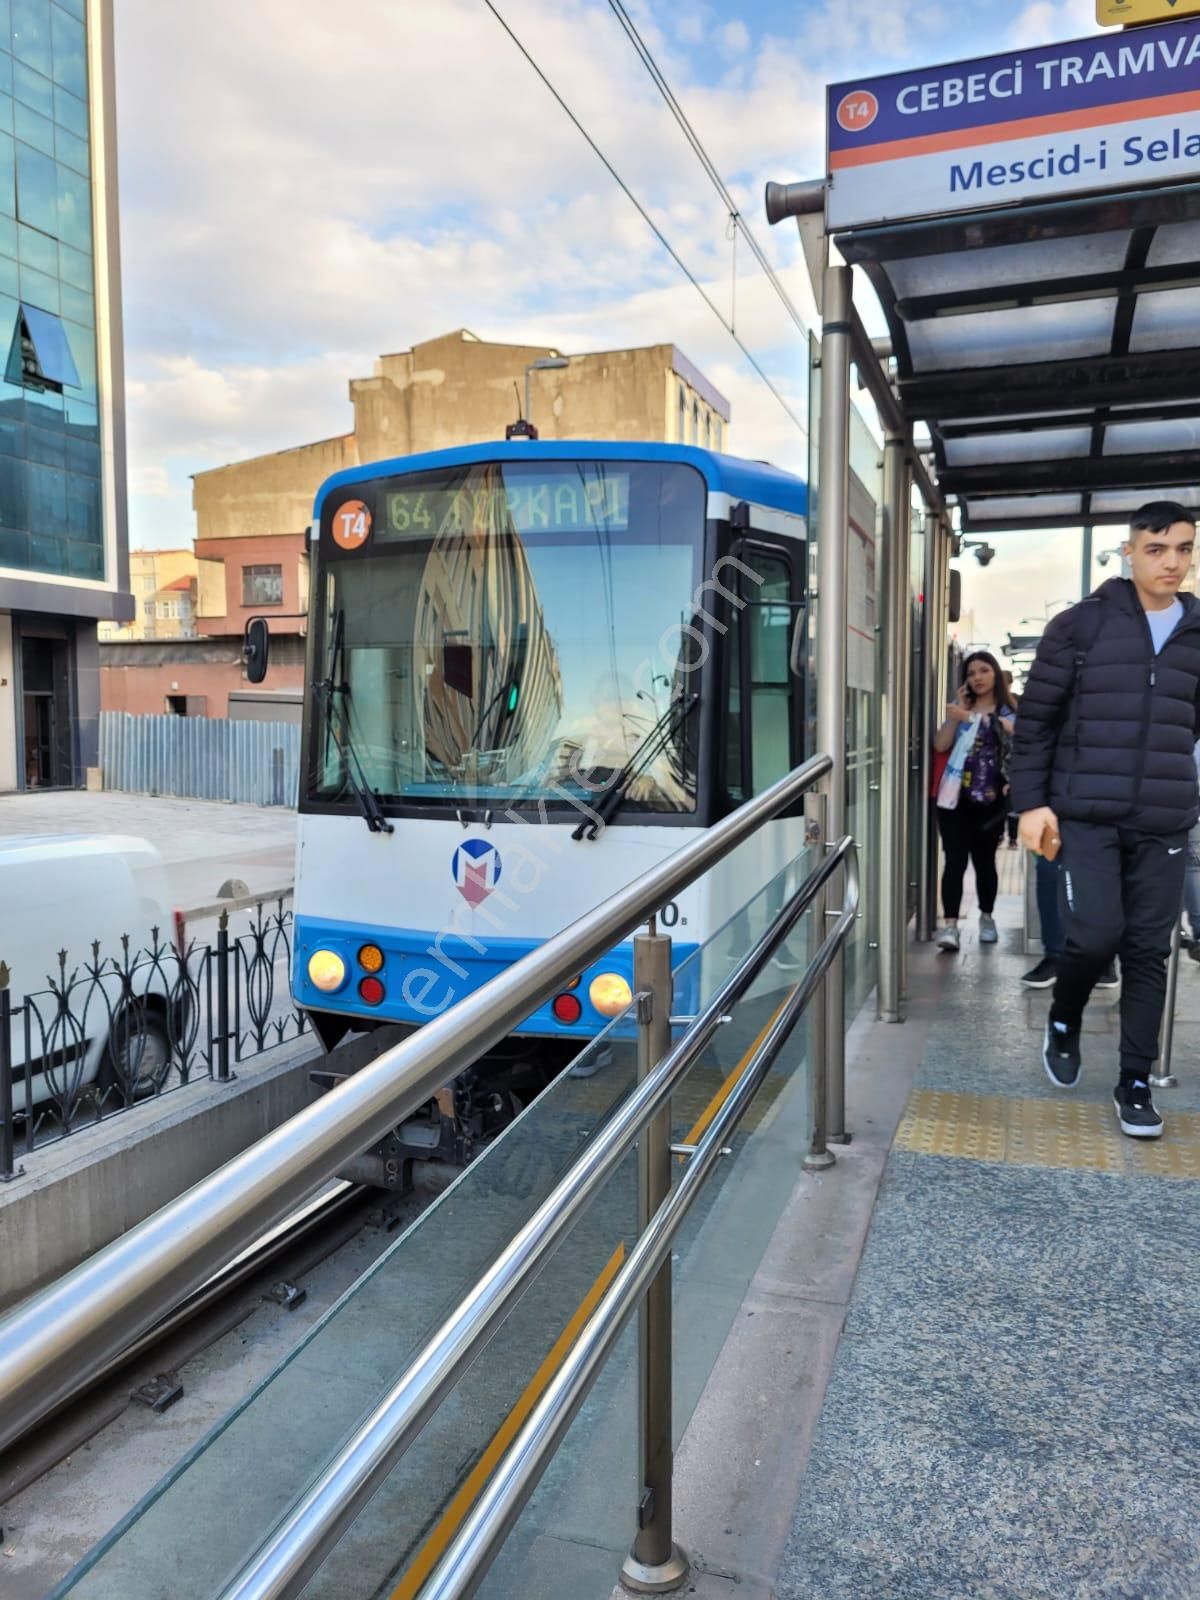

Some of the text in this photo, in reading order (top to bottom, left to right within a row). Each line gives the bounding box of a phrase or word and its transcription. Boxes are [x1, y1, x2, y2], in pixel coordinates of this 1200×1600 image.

[846, 103, 869, 120] T4
[896, 61, 1023, 115] CEBECİ
[949, 140, 1106, 193] Mescid-i
[340, 512, 366, 539] T4
[391, 491, 431, 532] 64
